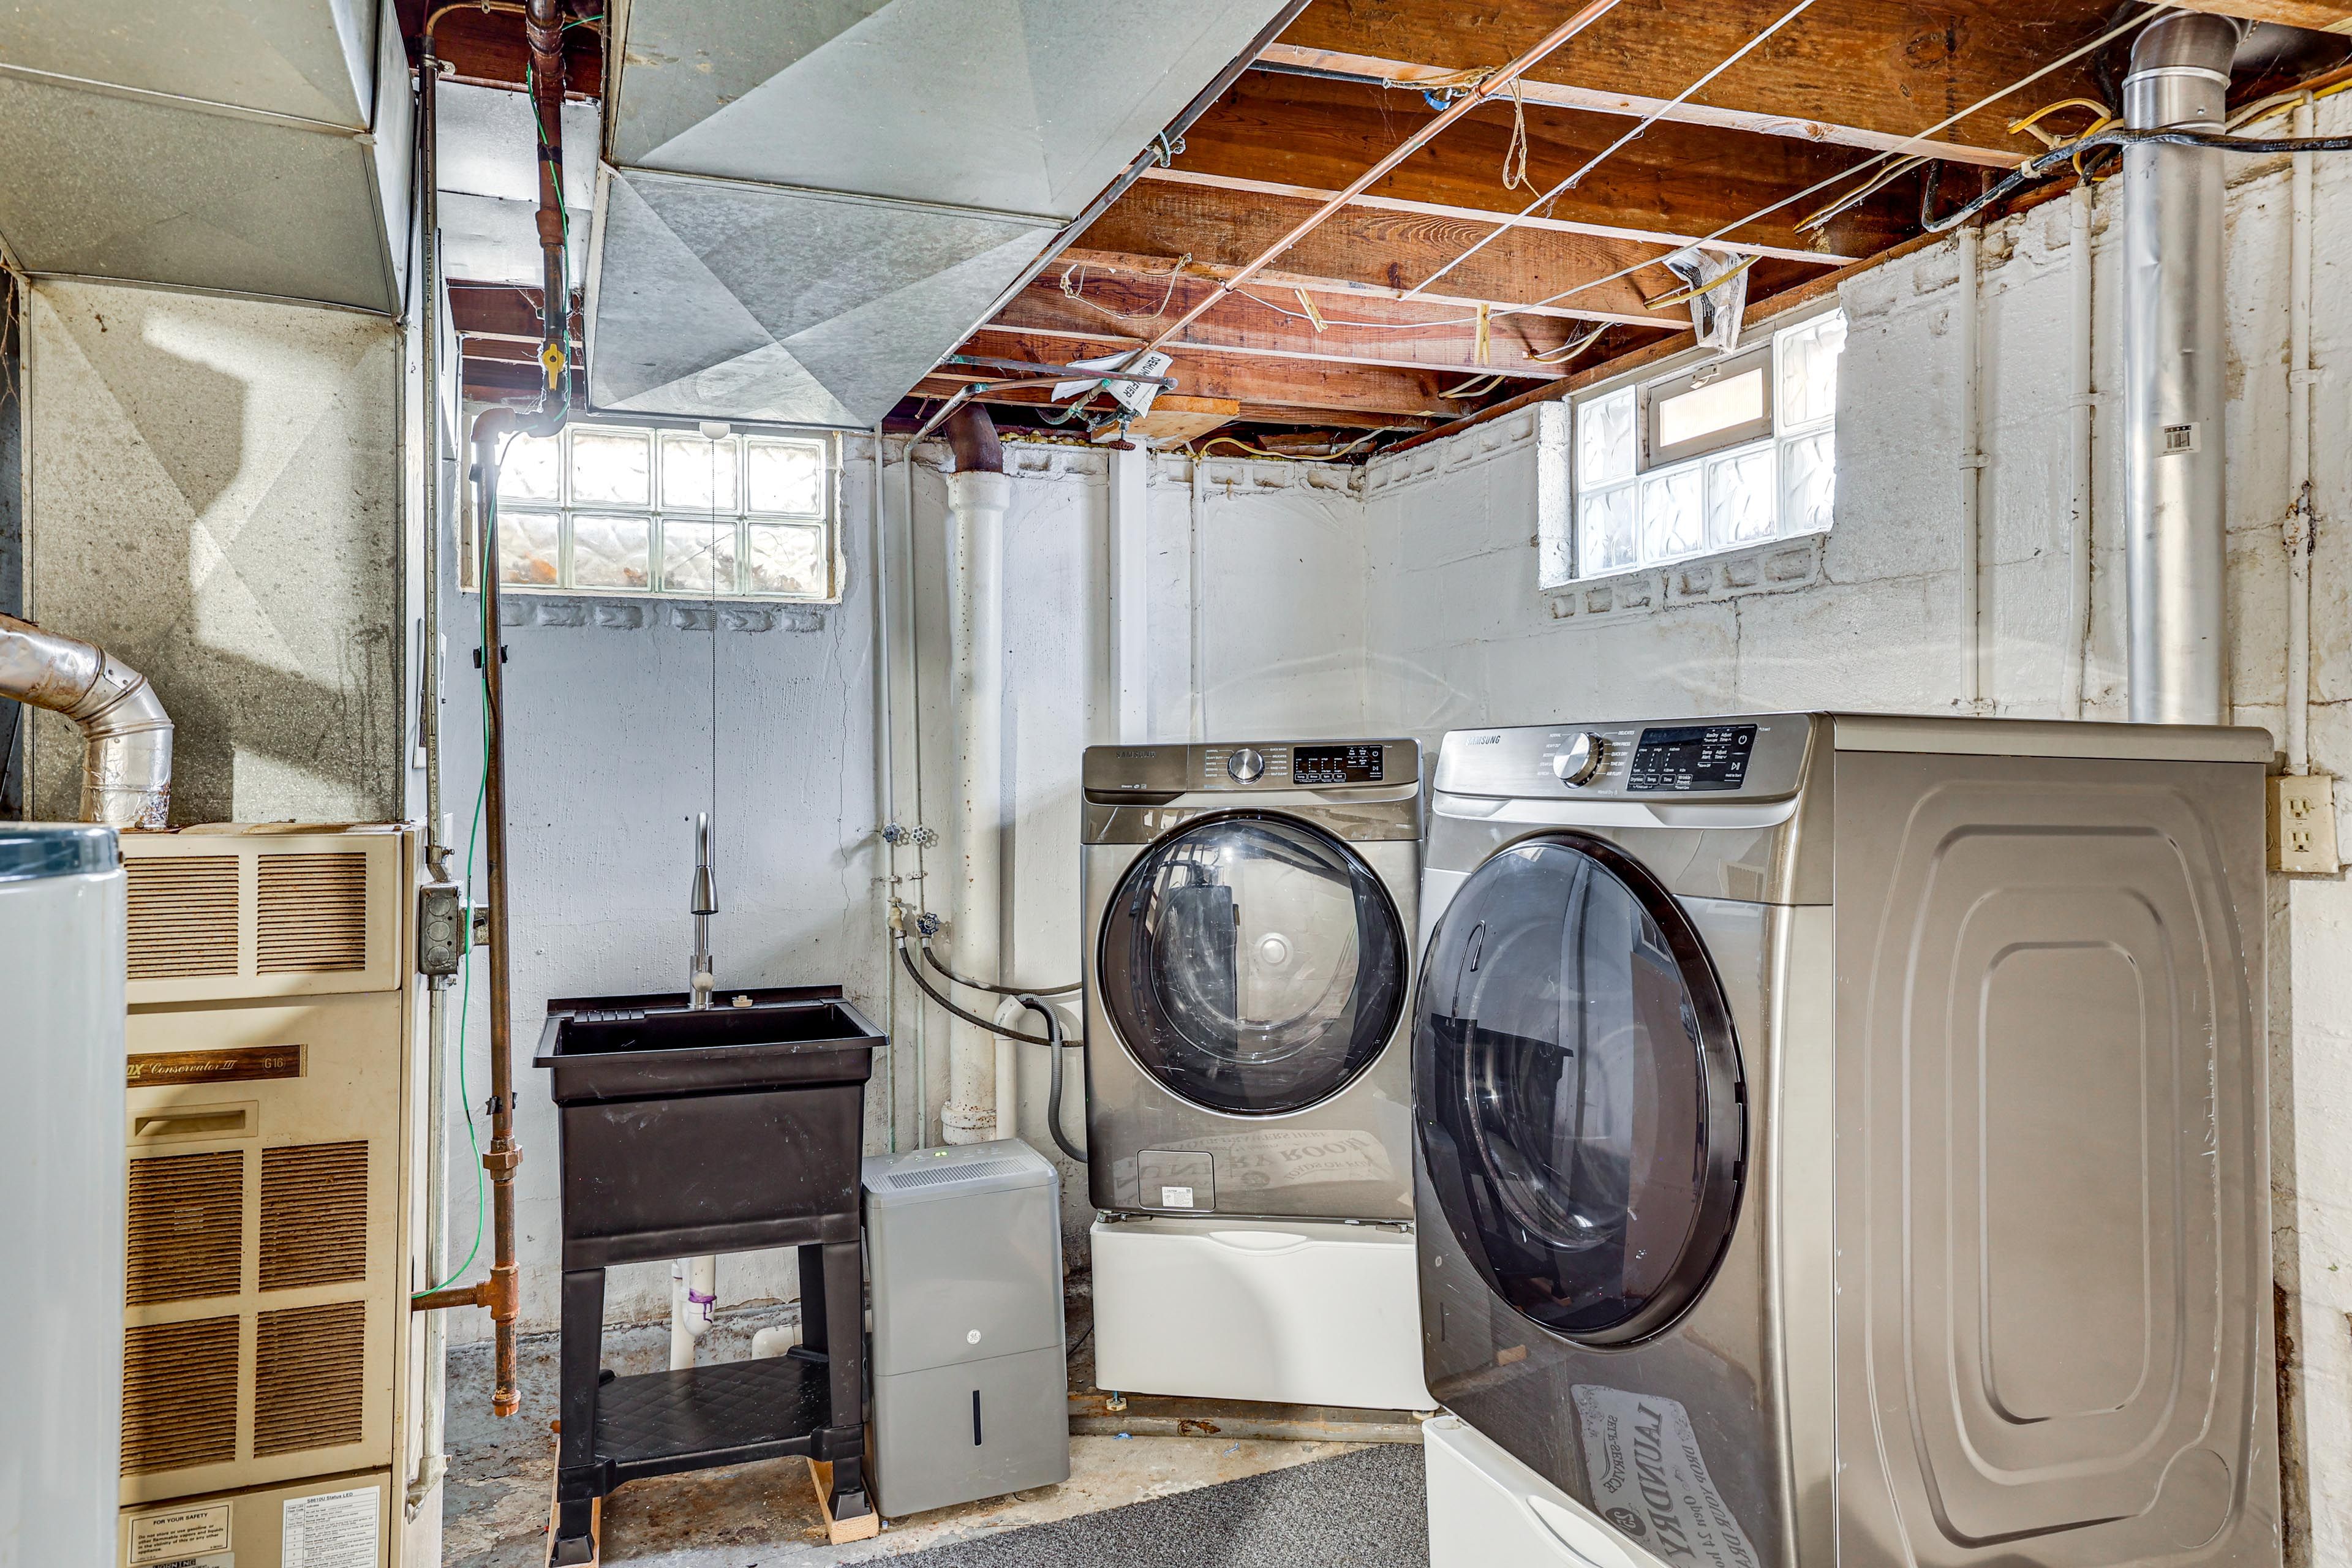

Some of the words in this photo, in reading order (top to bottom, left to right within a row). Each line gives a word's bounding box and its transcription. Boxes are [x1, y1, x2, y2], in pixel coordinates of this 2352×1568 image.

[1123, 356, 1161, 398] DEHUMFIER
[1466, 735, 1501, 745] SAMSUNG
[264, 1057, 284, 1068] G16
